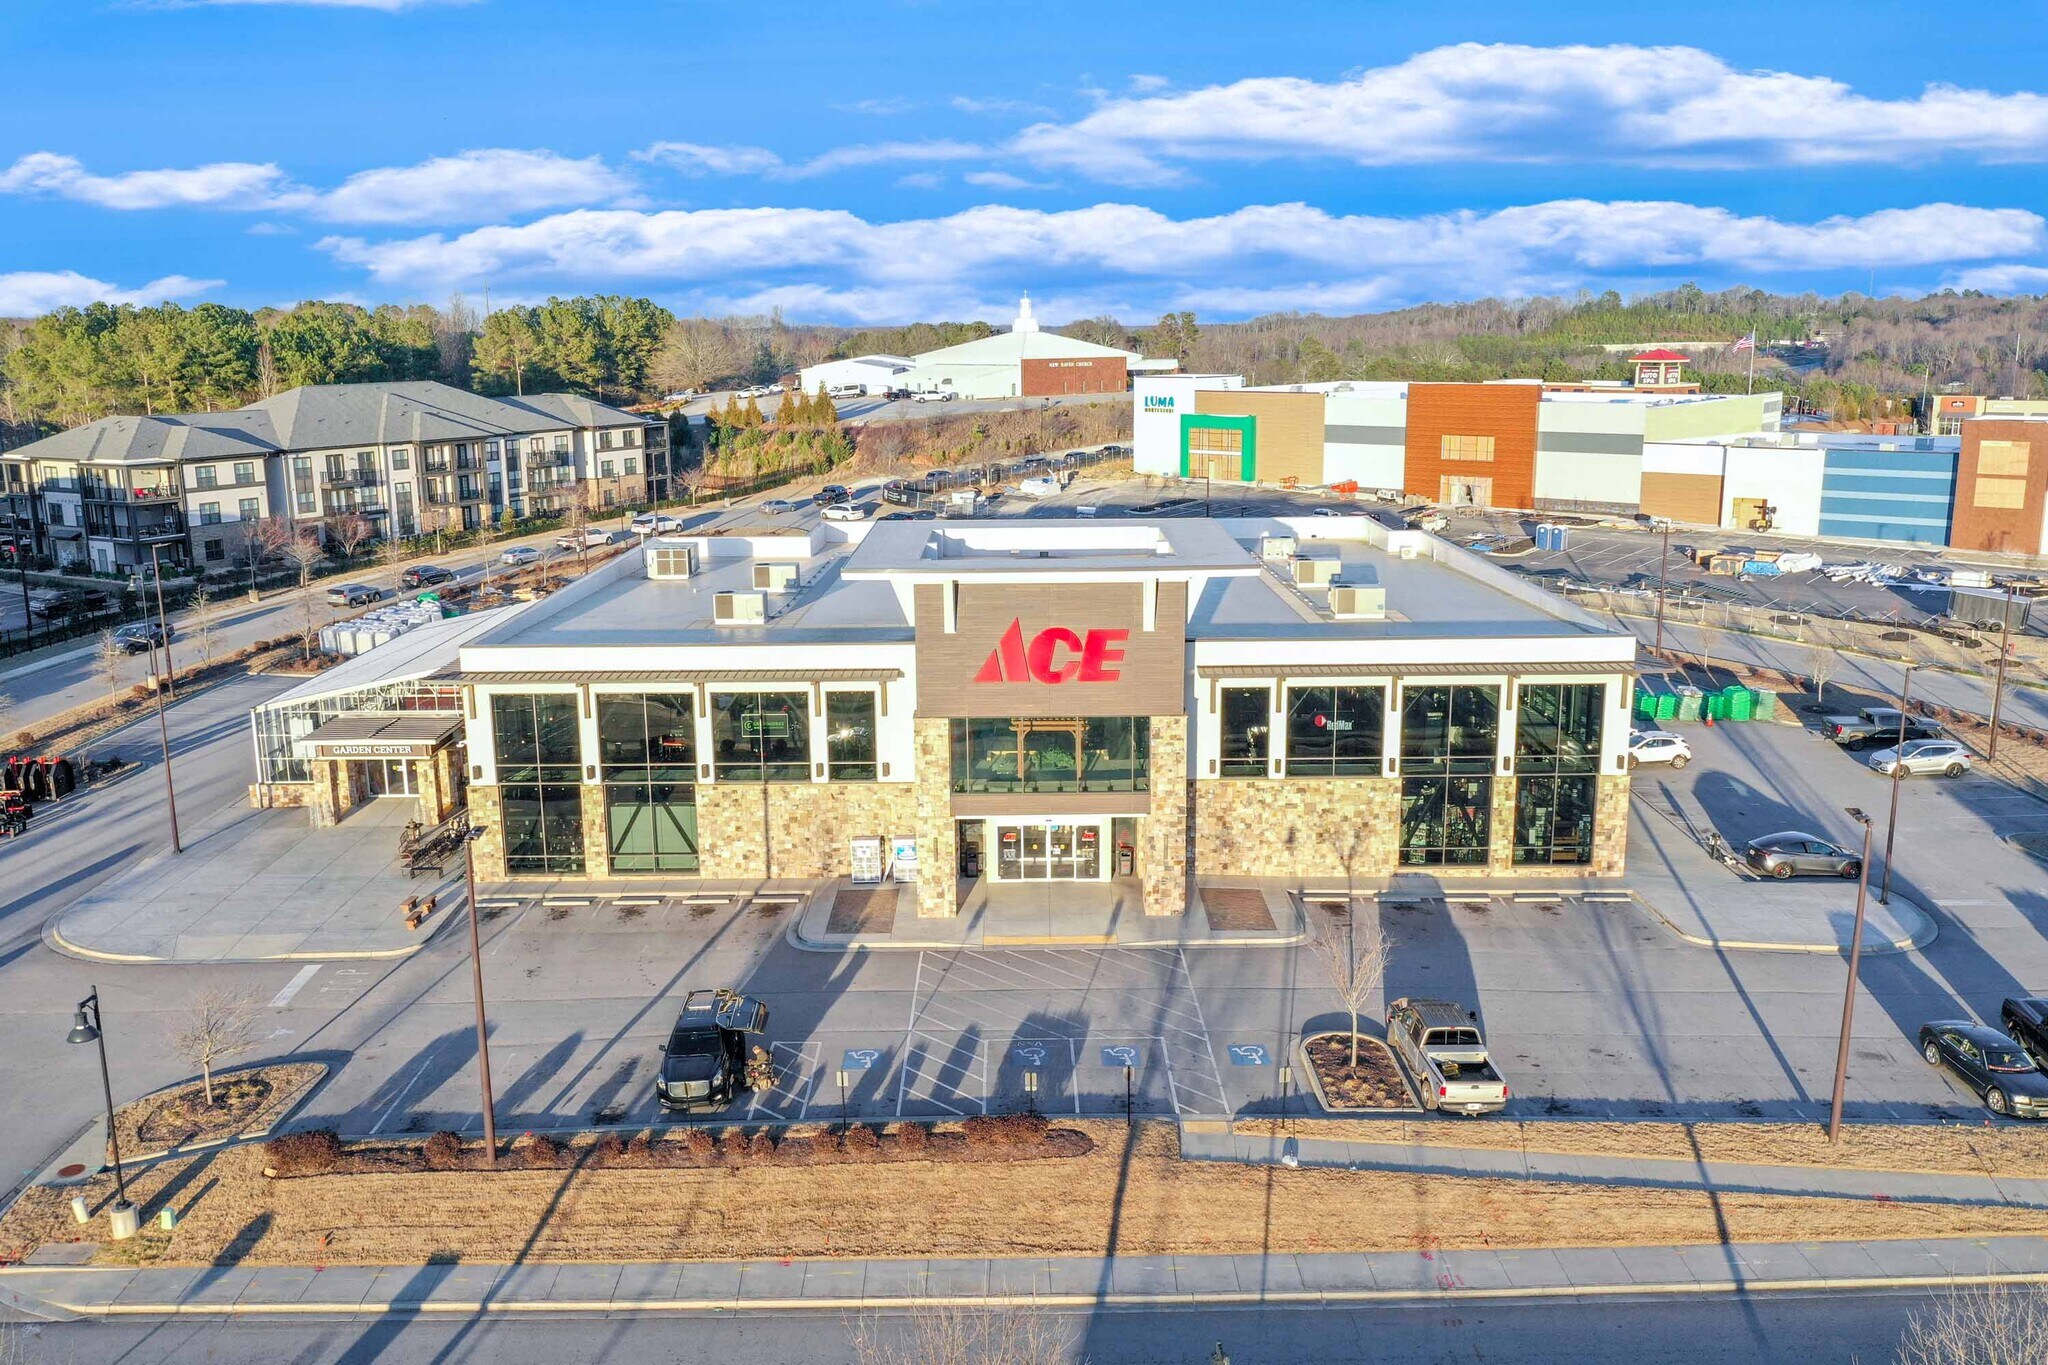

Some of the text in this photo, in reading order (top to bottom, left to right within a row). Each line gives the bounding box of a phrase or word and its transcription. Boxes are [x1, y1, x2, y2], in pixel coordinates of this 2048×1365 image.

[1144, 396, 1174, 407] LUMA
[973, 616, 1129, 684] ACE
[1327, 720, 1352, 730] RedMax
[333, 745, 413, 754] GARDEN CENTER
